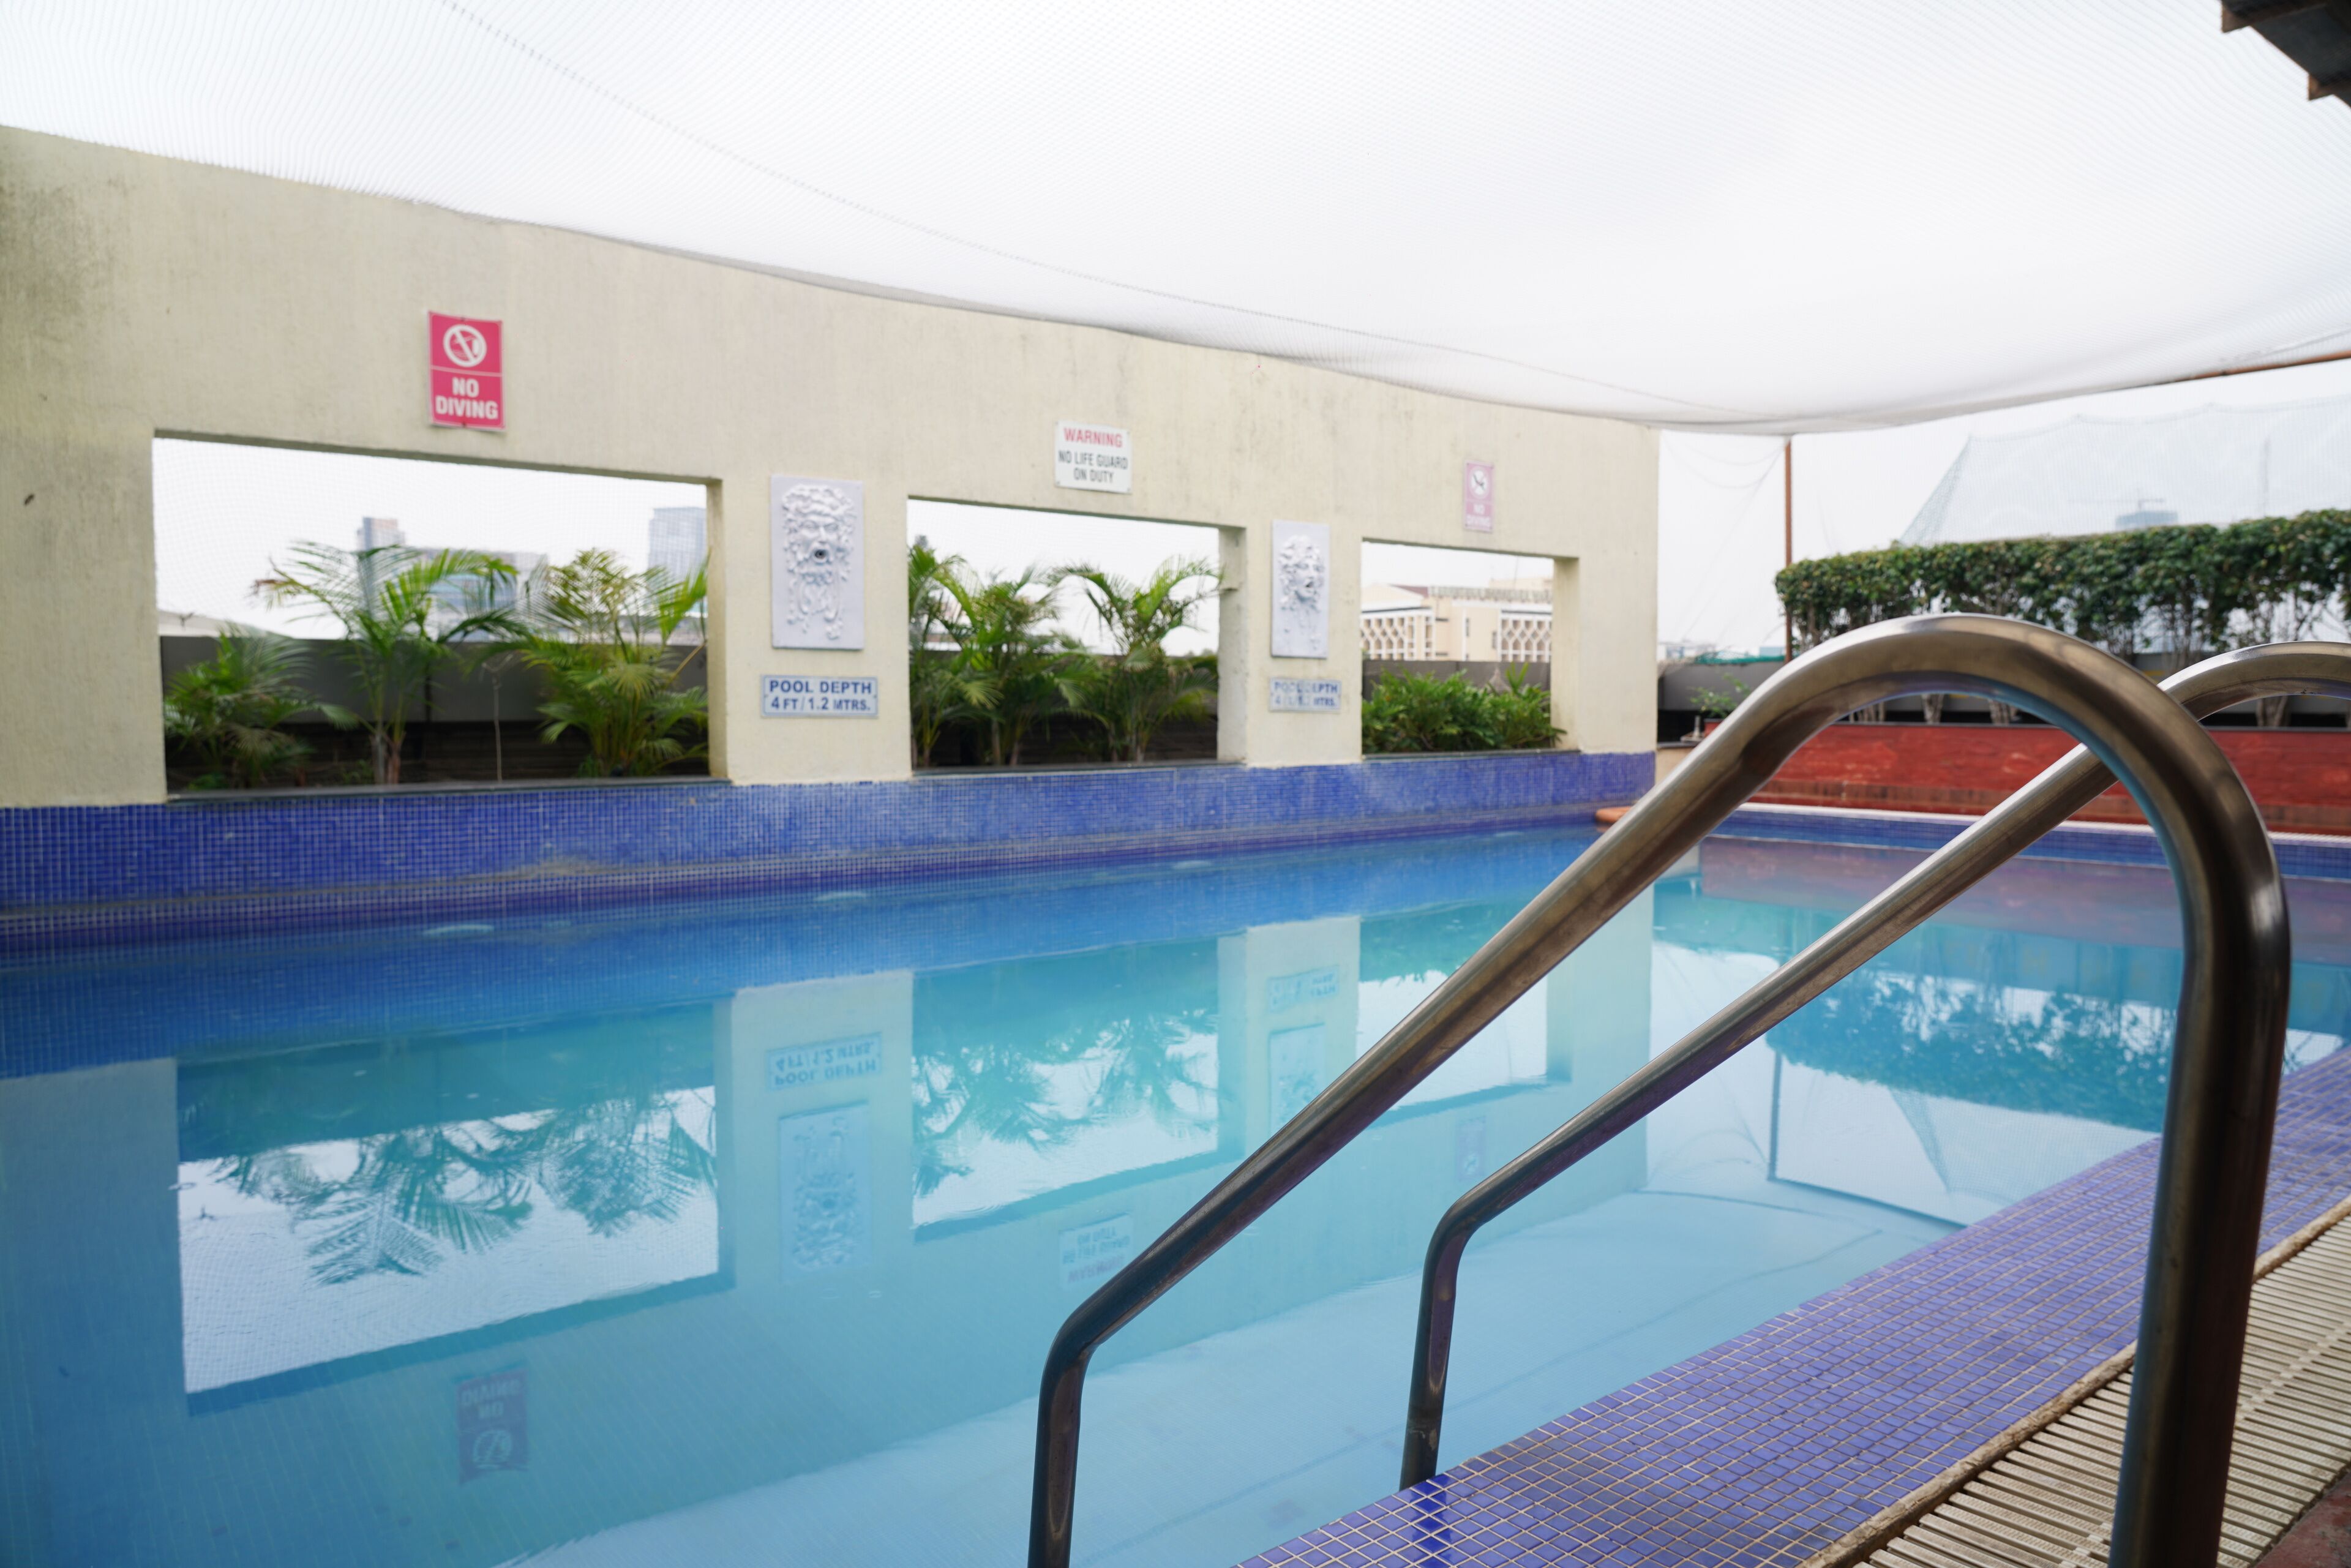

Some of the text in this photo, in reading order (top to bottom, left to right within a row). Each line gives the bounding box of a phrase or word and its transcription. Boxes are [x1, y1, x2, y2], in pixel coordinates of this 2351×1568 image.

[452, 377, 479, 397] NO
[435, 395, 499, 419] DIVING
[1063, 428, 1122, 448] WARNING
[1058, 451, 1128, 470] NO LIFE GUARD
[1073, 467, 1114, 483] ON DUTY
[770, 680, 871, 694] POOL DEPTH
